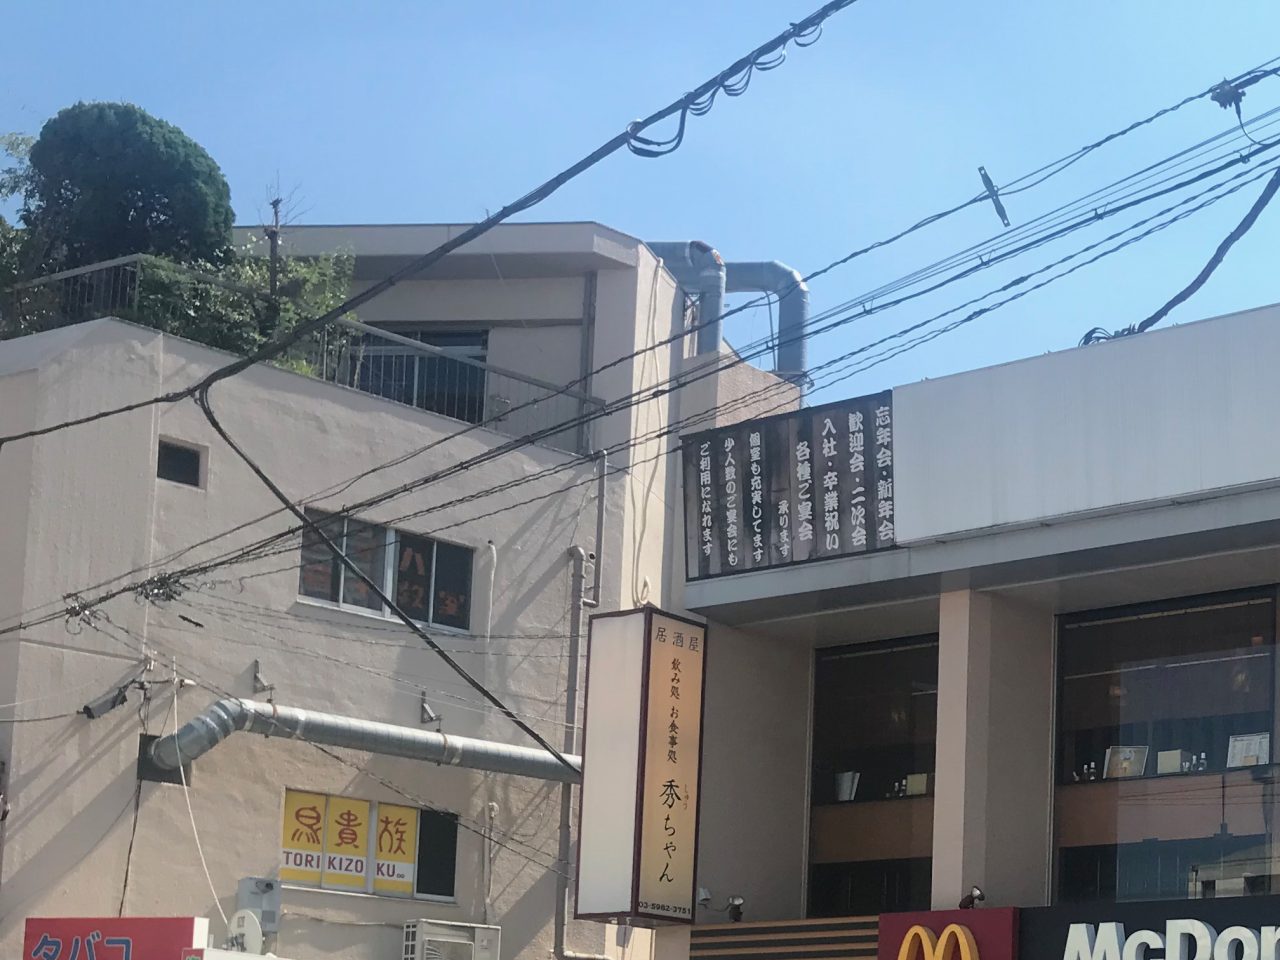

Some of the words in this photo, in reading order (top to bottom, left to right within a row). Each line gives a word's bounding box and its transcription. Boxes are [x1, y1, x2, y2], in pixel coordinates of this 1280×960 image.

[699, 441, 713, 557] ご利用になれます
[777, 500, 790, 558] 承ります
[796, 441, 813, 541] 各種ご宴会
[655, 626, 700, 652] 居酒屋
[658, 779, 682, 883] 秀ちゃん
